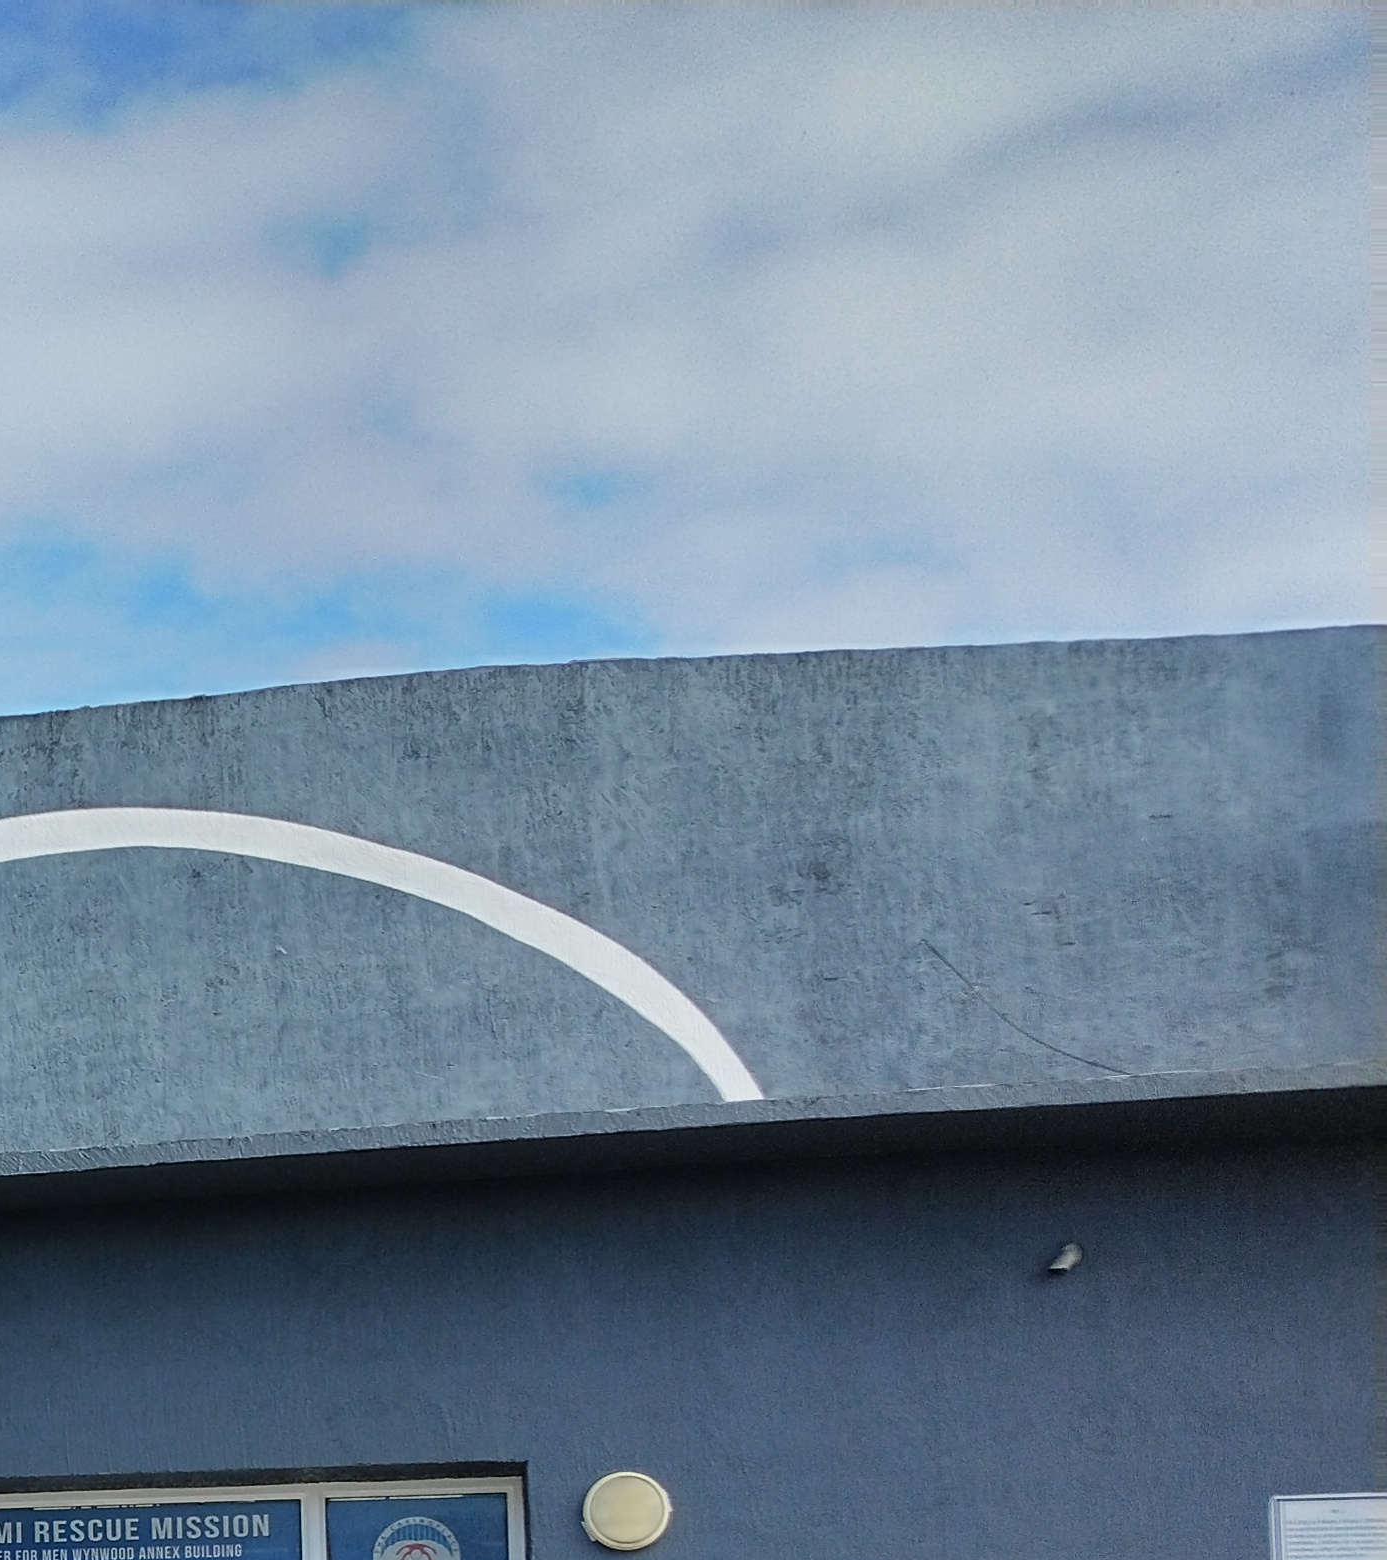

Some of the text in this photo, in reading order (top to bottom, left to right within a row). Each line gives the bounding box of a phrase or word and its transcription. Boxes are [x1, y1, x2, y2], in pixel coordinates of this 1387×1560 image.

[34, 1518, 139, 1544] RESCUE
[151, 1514, 270, 1540] MISSION
[138, 1545, 181, 1560] ANNEX
[185, 1544, 242, 1559] BUILDING
